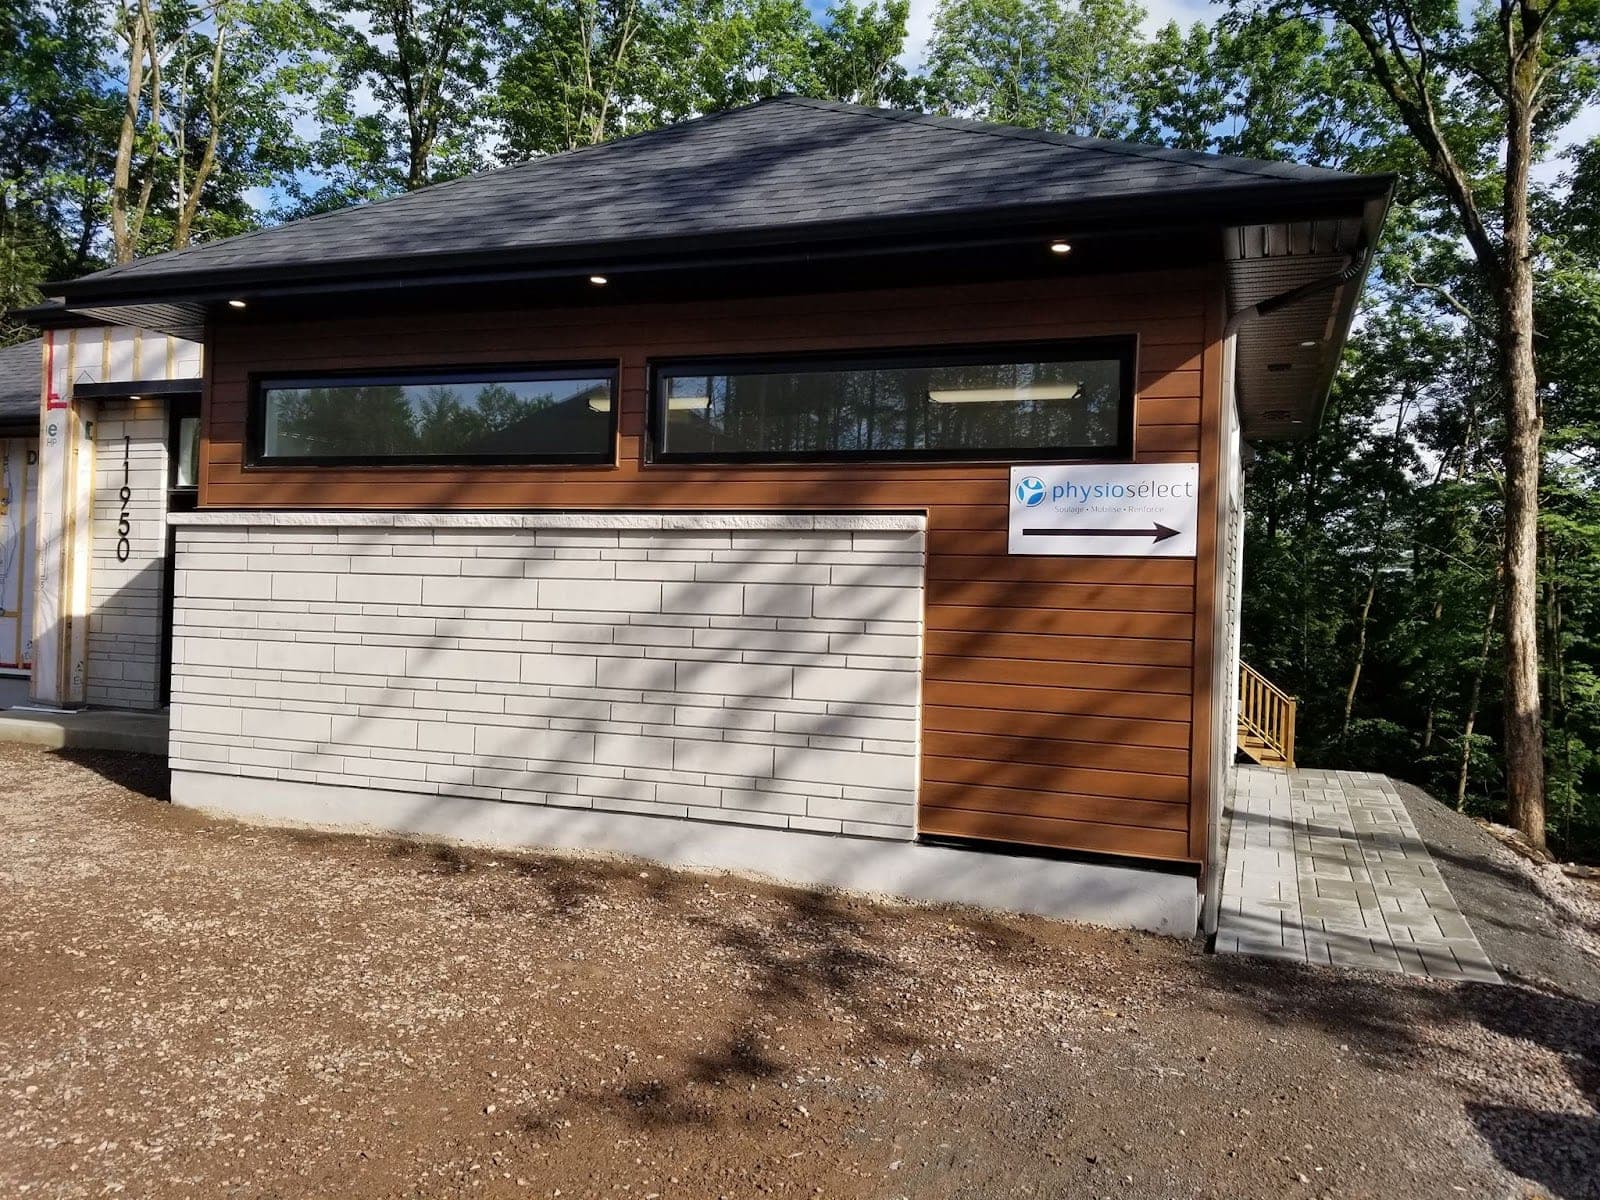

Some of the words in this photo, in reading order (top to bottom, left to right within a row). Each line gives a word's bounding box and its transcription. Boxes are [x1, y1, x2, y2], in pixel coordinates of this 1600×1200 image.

[117, 435, 131, 563] 11950
[1052, 479, 1193, 503] physiosélect
[1053, 505, 1084, 515] Soulage
